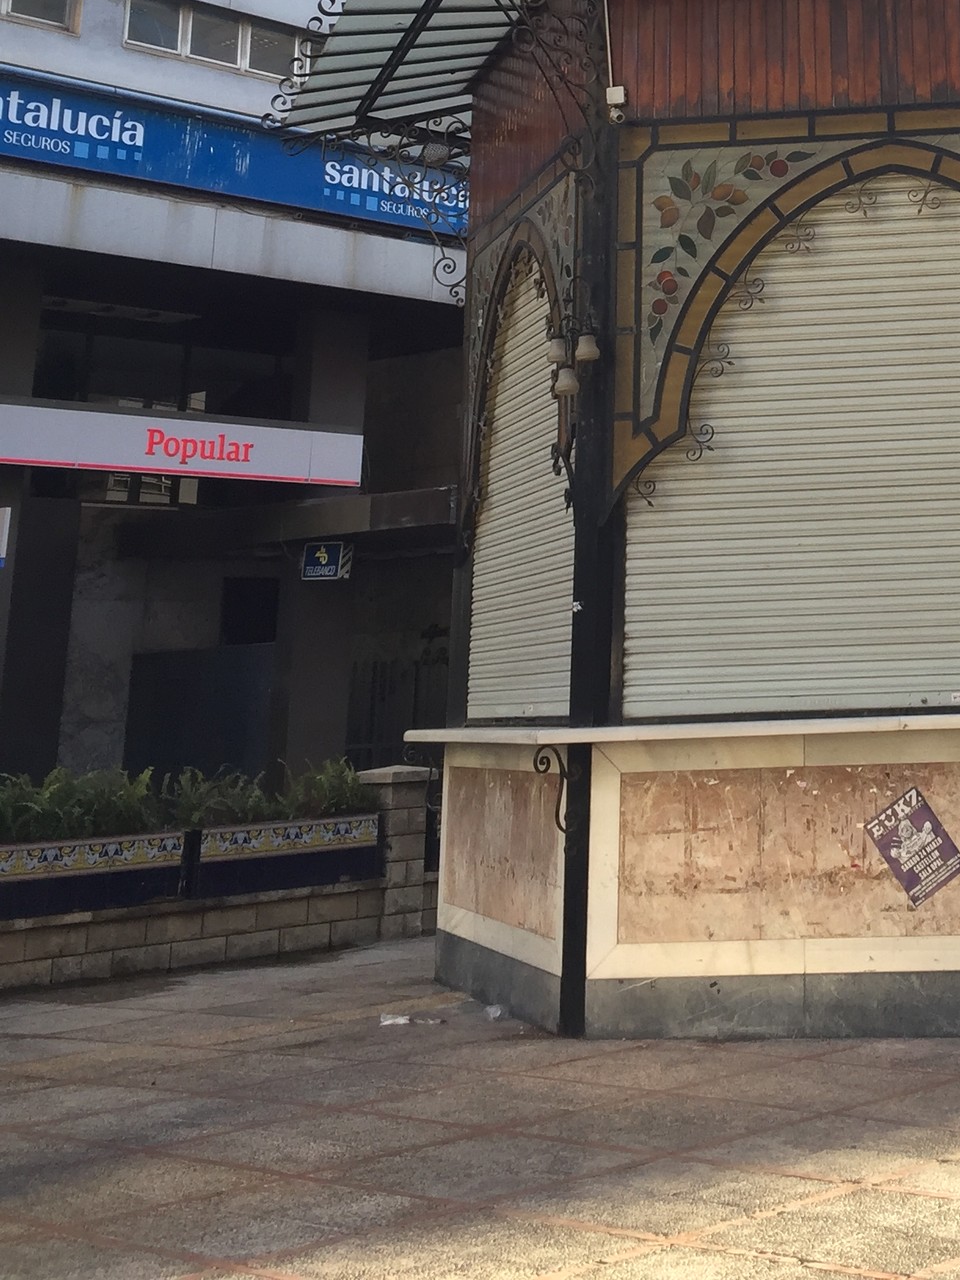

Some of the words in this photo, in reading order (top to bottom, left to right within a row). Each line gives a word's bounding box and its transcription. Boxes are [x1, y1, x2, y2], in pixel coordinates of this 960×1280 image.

[0, 90, 145, 147] talucía
[3, 129, 71, 154] SEGUROS
[324, 161, 469, 208] santalucí
[380, 199, 430, 218] SEGUROS
[145, 428, 254, 465] Popular
